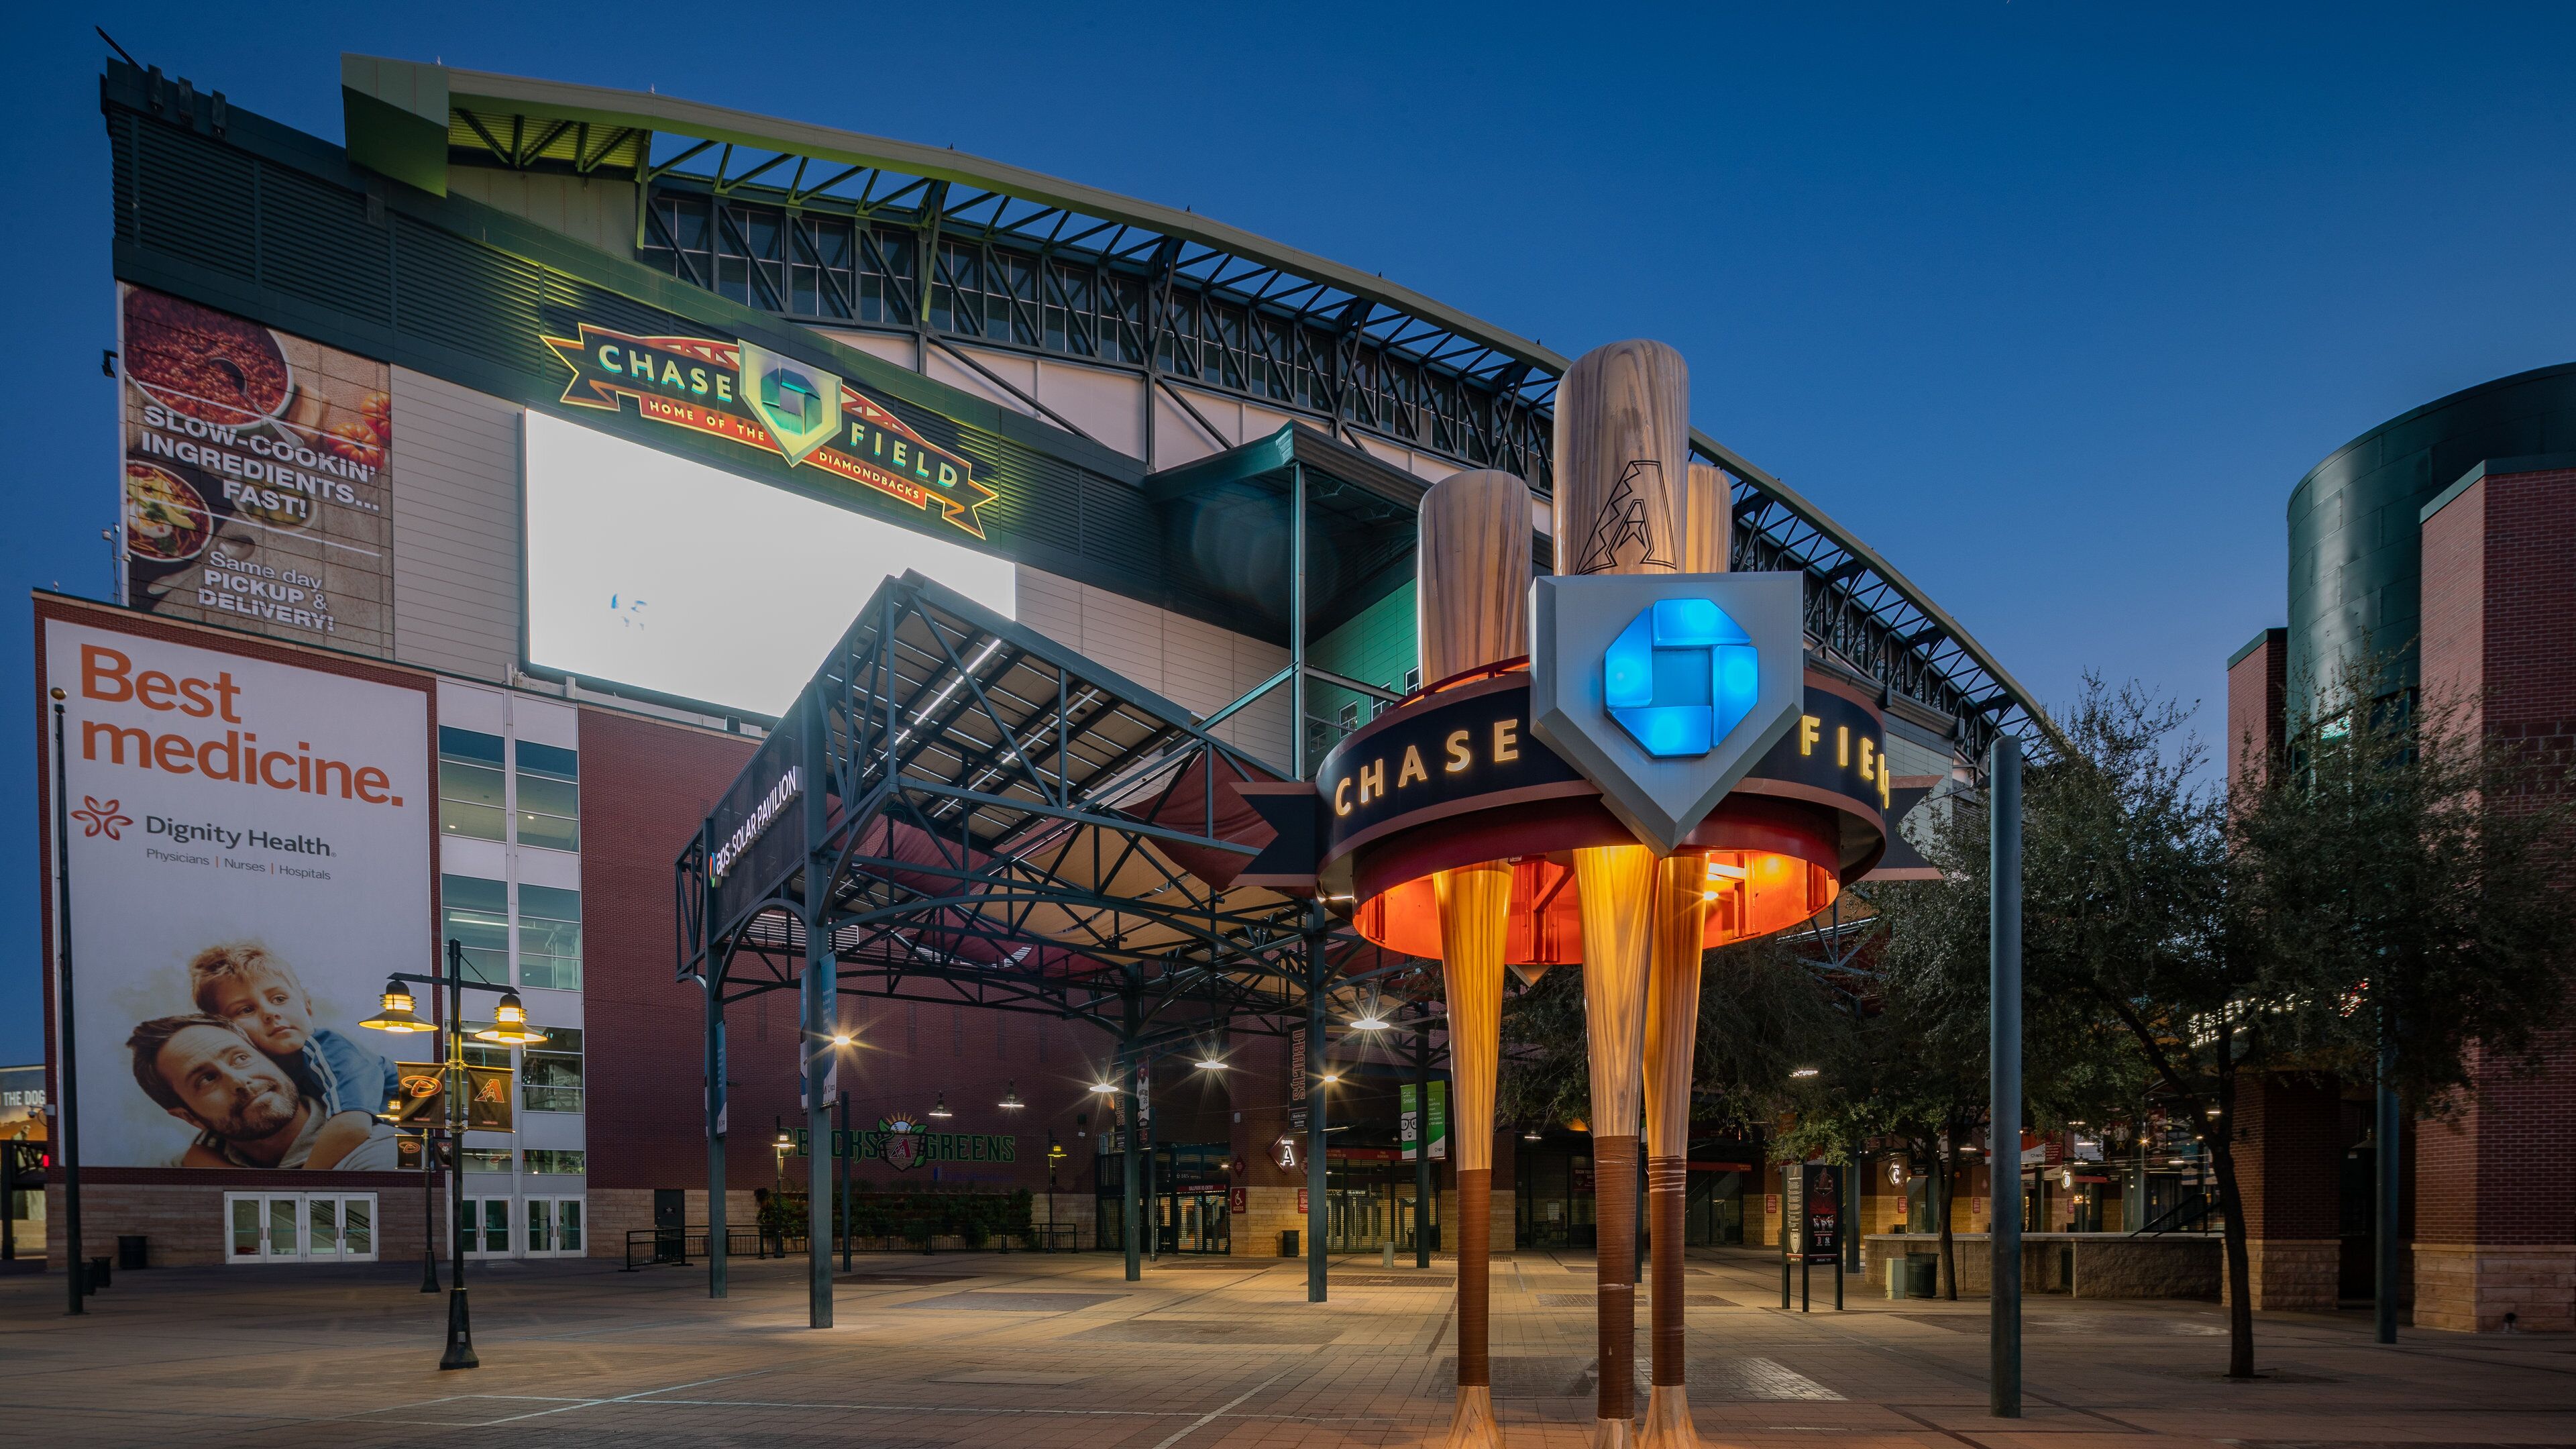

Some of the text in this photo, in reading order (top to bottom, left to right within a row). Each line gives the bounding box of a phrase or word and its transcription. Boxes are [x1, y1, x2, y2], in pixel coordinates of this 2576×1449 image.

[598, 345, 959, 489] CHASE FIELD
[143, 405, 376, 483] SLOW-COOKIN'
[649, 400, 920, 500] HOME OF THE DIAMONDBACKS
[141, 430, 380, 512] INGREDIENTS...
[222, 477, 307, 519] FAST!
[203, 569, 329, 612] PICKUP &
[209, 550, 323, 592] Same day
[198, 588, 335, 632] DELIVERY!
[80, 643, 241, 724] Best
[82, 719, 404, 808] medicine.
[1335, 714, 1890, 817] CHASE FIEL
[146, 815, 242, 849] Dignity
[716, 765, 796, 877] aps SOLAR PAVILION
[146, 847, 331, 881] Physicians Nurses Hospitals
[3, 1091, 22, 1106] THE
[924, 1132, 1016, 1163] GREENS
[1279, 1144, 1295, 1166] A
